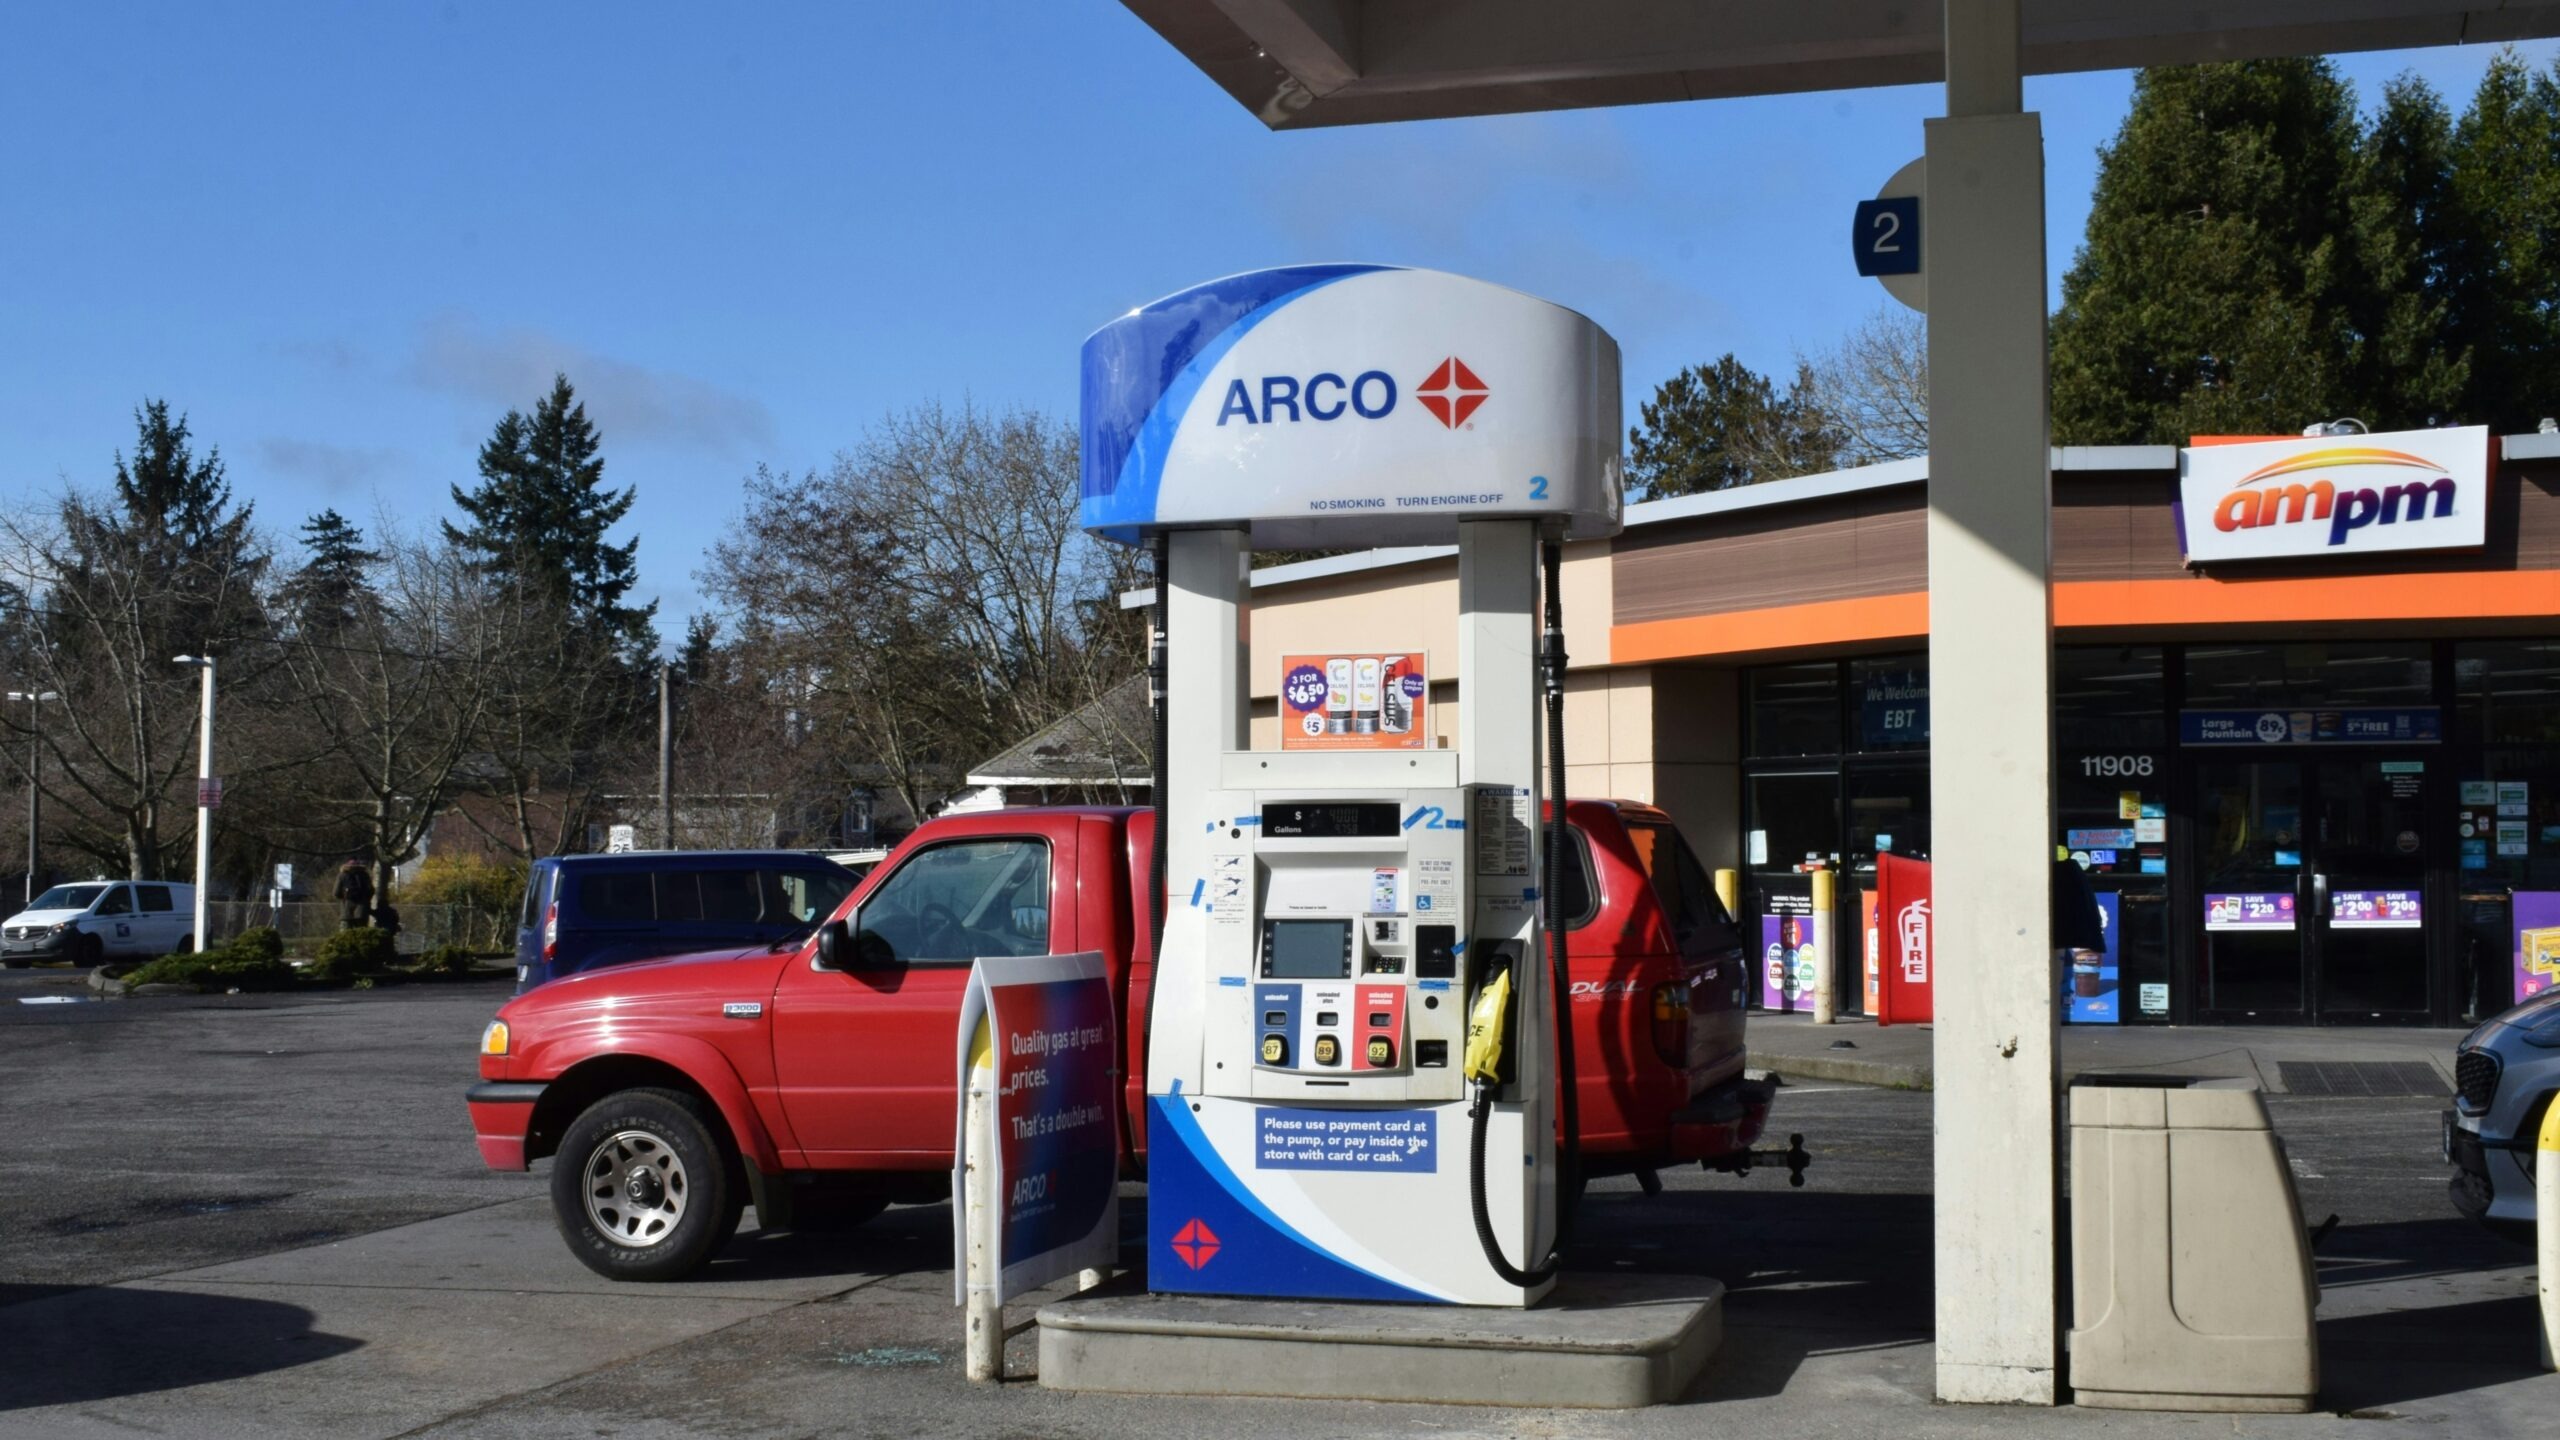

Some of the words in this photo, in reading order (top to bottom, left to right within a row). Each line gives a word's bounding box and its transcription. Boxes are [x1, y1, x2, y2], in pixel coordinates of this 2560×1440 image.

[1873, 212, 1900, 252] 2
[1216, 370, 1397, 427] ARCO
[1529, 476, 1549, 500] 2
[1310, 501, 1327, 510] NO
[1329, 498, 1385, 509] SMOKING
[1396, 497, 1429, 507] TURN
[1431, 494, 1477, 505] ENGINE
[1479, 494, 1503, 504] OFF
[2213, 478, 2457, 546] ampm
[1292, 676, 1298, 684] 3
[1300, 674, 1318, 683] FOR
[1867, 688, 1883, 702] We
[1884, 686, 1930, 701] Welcom
[1884, 708, 1916, 729] EBT
[2202, 719, 2234, 731] Large
[1306, 721, 1320, 733] $5
[2202, 729, 2253, 739] Fountain
[2363, 722, 2389, 732] FREE
[2081, 756, 2153, 776] 11908
[1426, 806, 1444, 829] 2
[1275, 825, 1302, 833] Gallons
[1909, 922, 1923, 975] FIRE
[1569, 979, 1646, 994] DUAL
[1012, 1030, 1050, 1056] Quality
[1052, 1032, 1068, 1055] gas
[1070, 1027, 1079, 1047] at
[1081, 1024, 1102, 1051] great
[1265, 1045, 1278, 1054] 87
[1318, 1047, 1331, 1055] 89
[1371, 1047, 1385, 1056] 92
[1011, 1065, 1049, 1096] prices.
[1012, 1112, 1045, 1139] That's
[1048, 1116, 1053, 1132] a
[1056, 1105, 1085, 1130] double
[1264, 1117, 1302, 1130] Please
[1305, 1121, 1325, 1130] use
[1330, 1121, 1381, 1132] payment
[1384, 1120, 1410, 1131] card
[1414, 1122, 1426, 1132] at
[1264, 1134, 1284, 1144] the
[1287, 1136, 1324, 1147] pump,
[1328, 1137, 1341, 1145] or
[1344, 1137, 1366, 1148] pay
[1370, 1135, 1404, 1146] inside
[1407, 1136, 1428, 1147] the
[1264, 1149, 1294, 1159] store
[1298, 1149, 1324, 1160] with
[1328, 1149, 1353, 1161] card
[1357, 1153, 1370, 1161] or
[1373, 1151, 1402, 1162] cash.
[1012, 1173, 1047, 1206] ARCO
